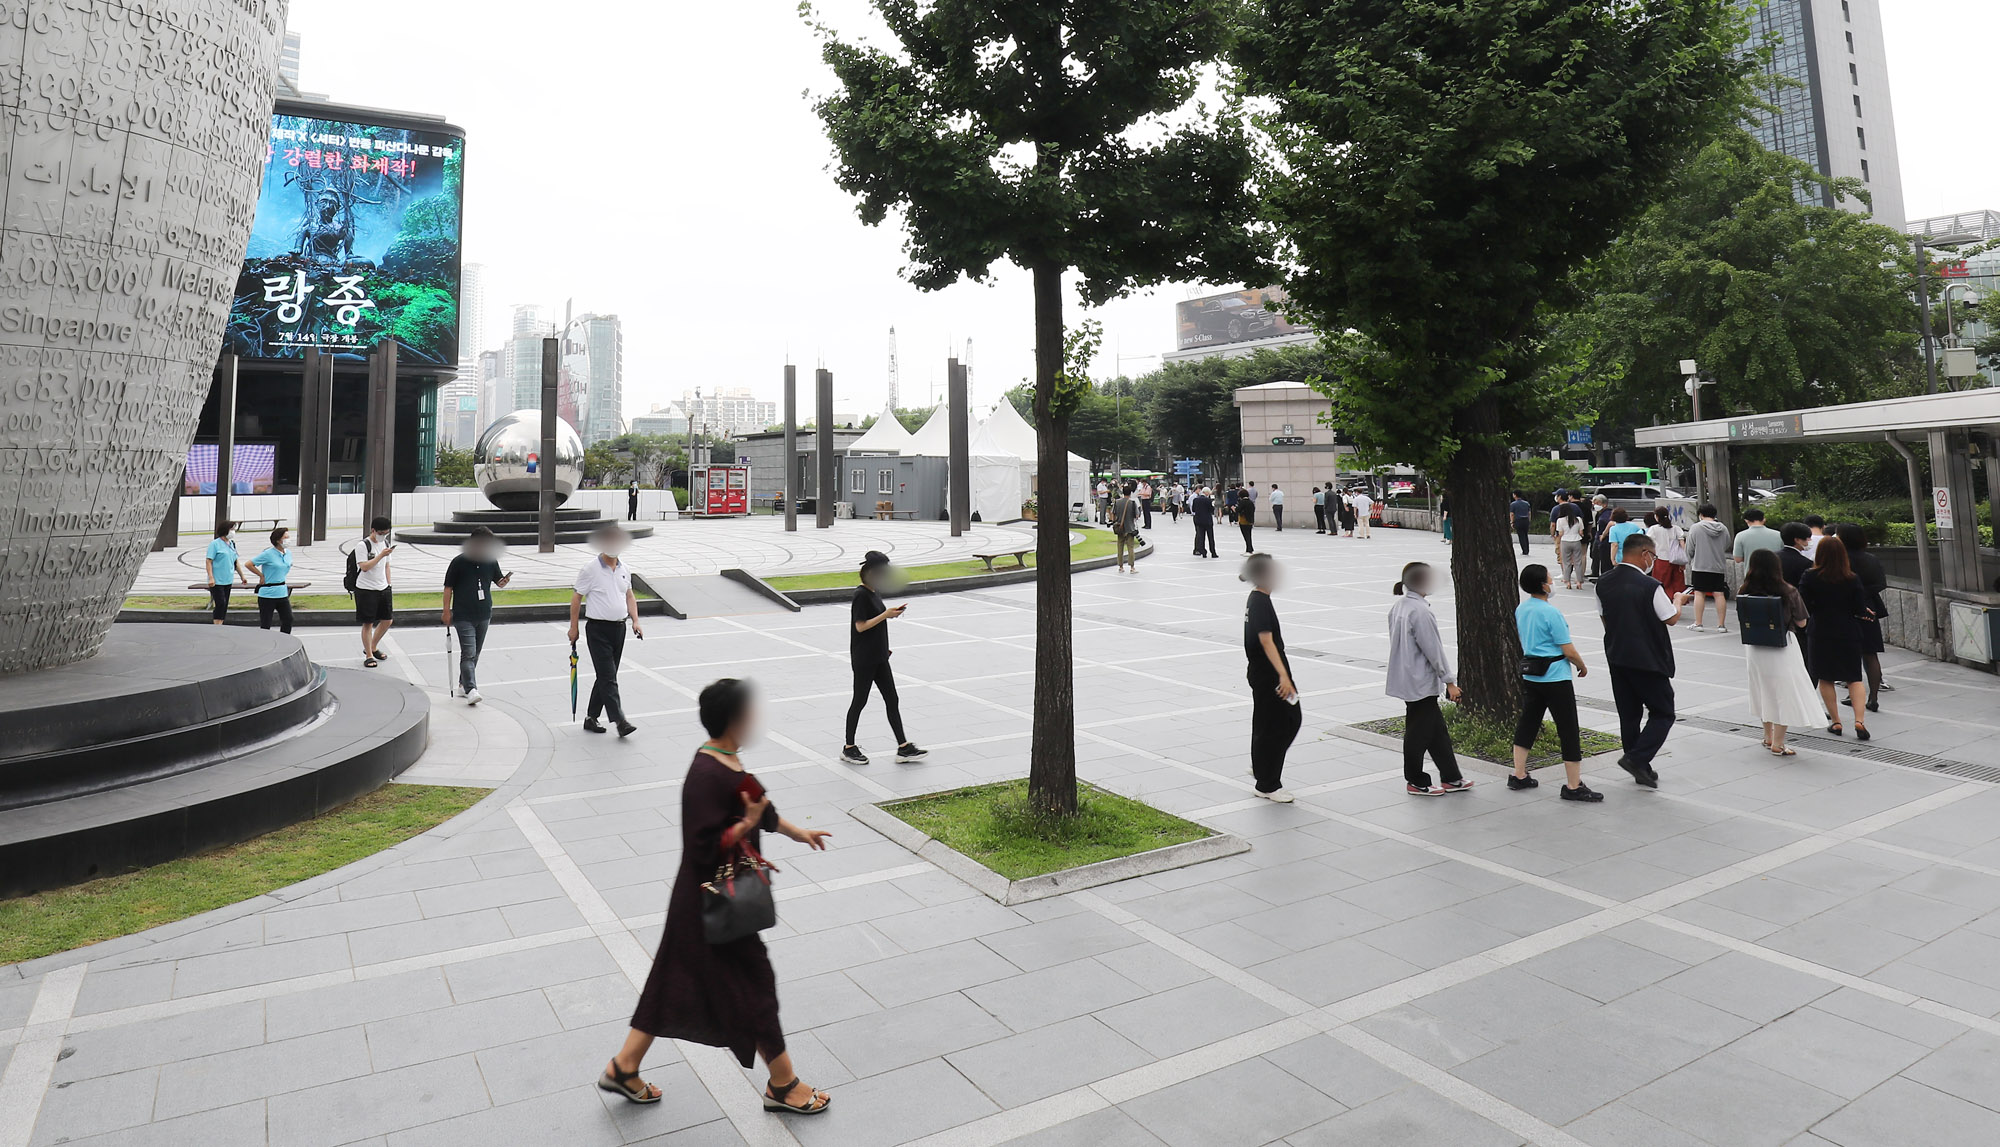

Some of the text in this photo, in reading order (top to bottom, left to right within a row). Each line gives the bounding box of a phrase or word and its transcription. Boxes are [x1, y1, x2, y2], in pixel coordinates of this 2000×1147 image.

[271, 128, 296, 141] 제작
[349, 137, 372, 150] 반종
[282, 146, 344, 171] 강렬한
[349, 154, 416, 178] 화제작!
[0, 304, 134, 346] Singapore
[18, 504, 114, 534] Indonesia
